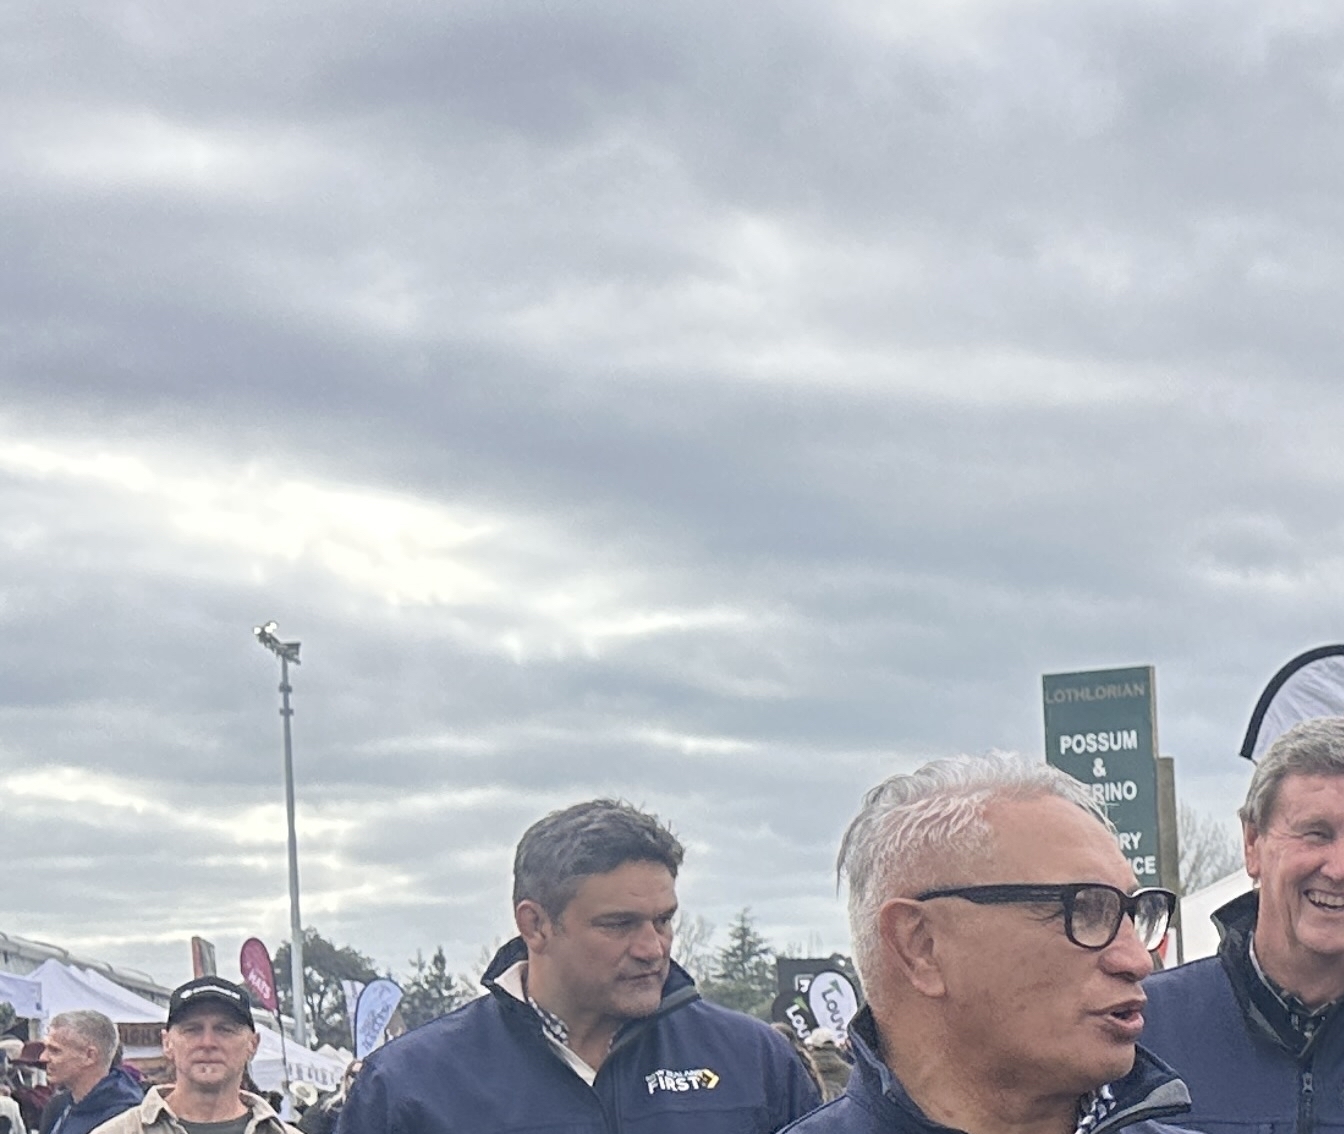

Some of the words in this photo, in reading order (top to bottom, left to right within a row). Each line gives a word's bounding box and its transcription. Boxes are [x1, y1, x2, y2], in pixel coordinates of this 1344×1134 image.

[1045, 682, 1145, 704] LOTHLORIAN
[1060, 729, 1138, 755] POSSUM
[1092, 757, 1107, 778] &
[646, 1075, 700, 1095] FIRST
